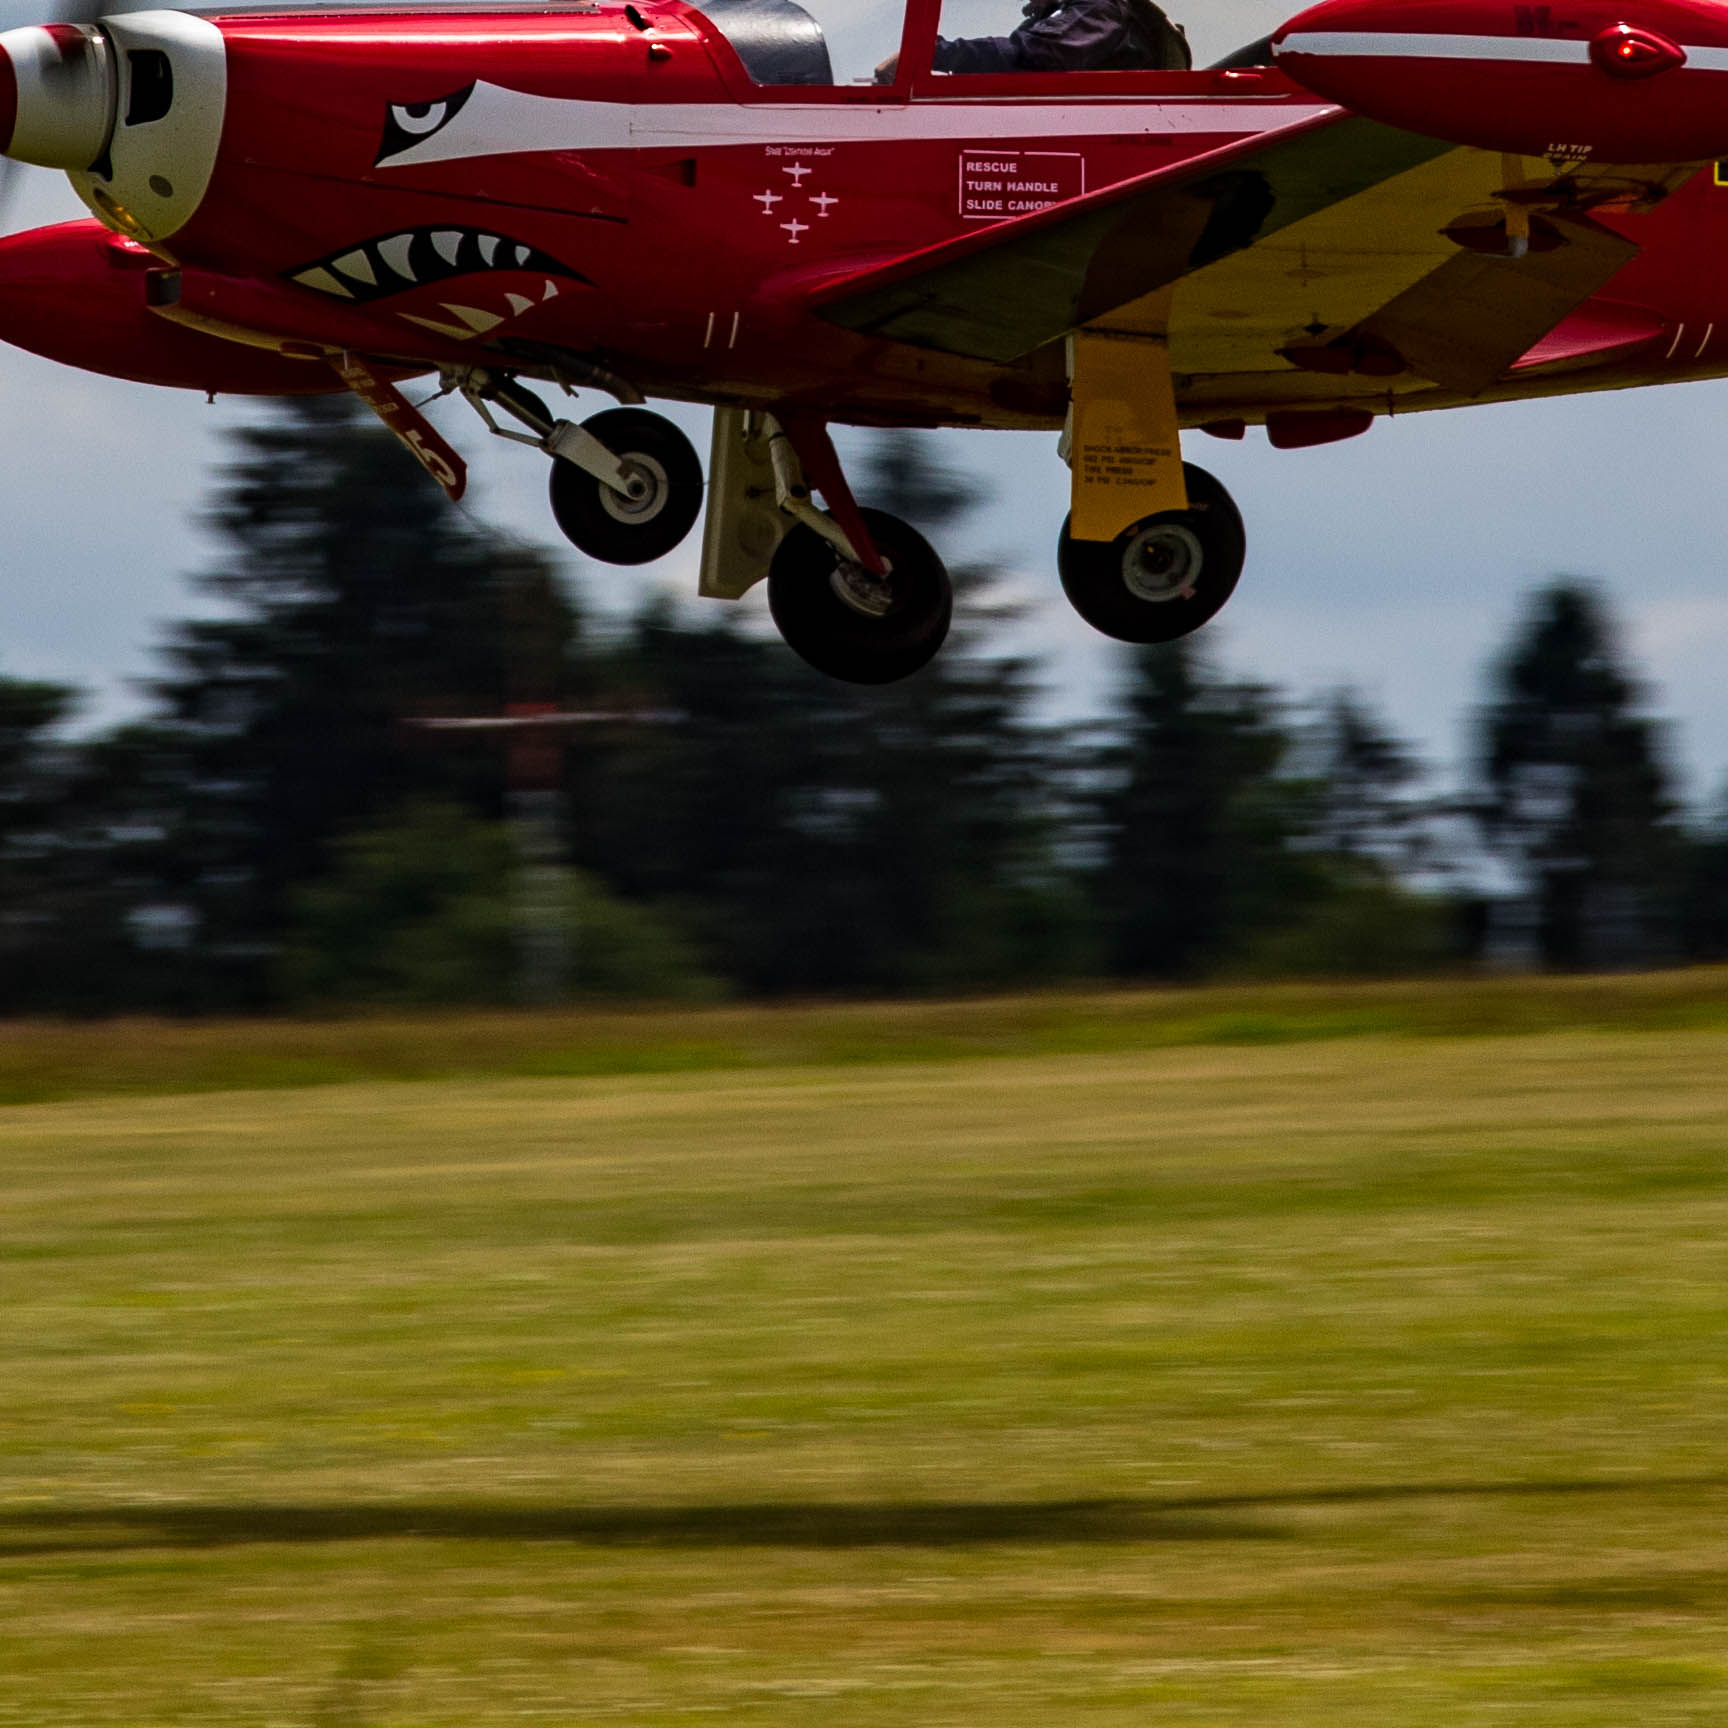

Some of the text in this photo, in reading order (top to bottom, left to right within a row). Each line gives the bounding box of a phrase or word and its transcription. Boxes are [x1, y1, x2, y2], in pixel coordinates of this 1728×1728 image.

[1549, 144, 1592, 153] LH TIP
[965, 161, 1018, 173] RESCUE
[965, 180, 1059, 193] TURN HANDLE
[965, 199, 1057, 211] SLIDE CANOP
